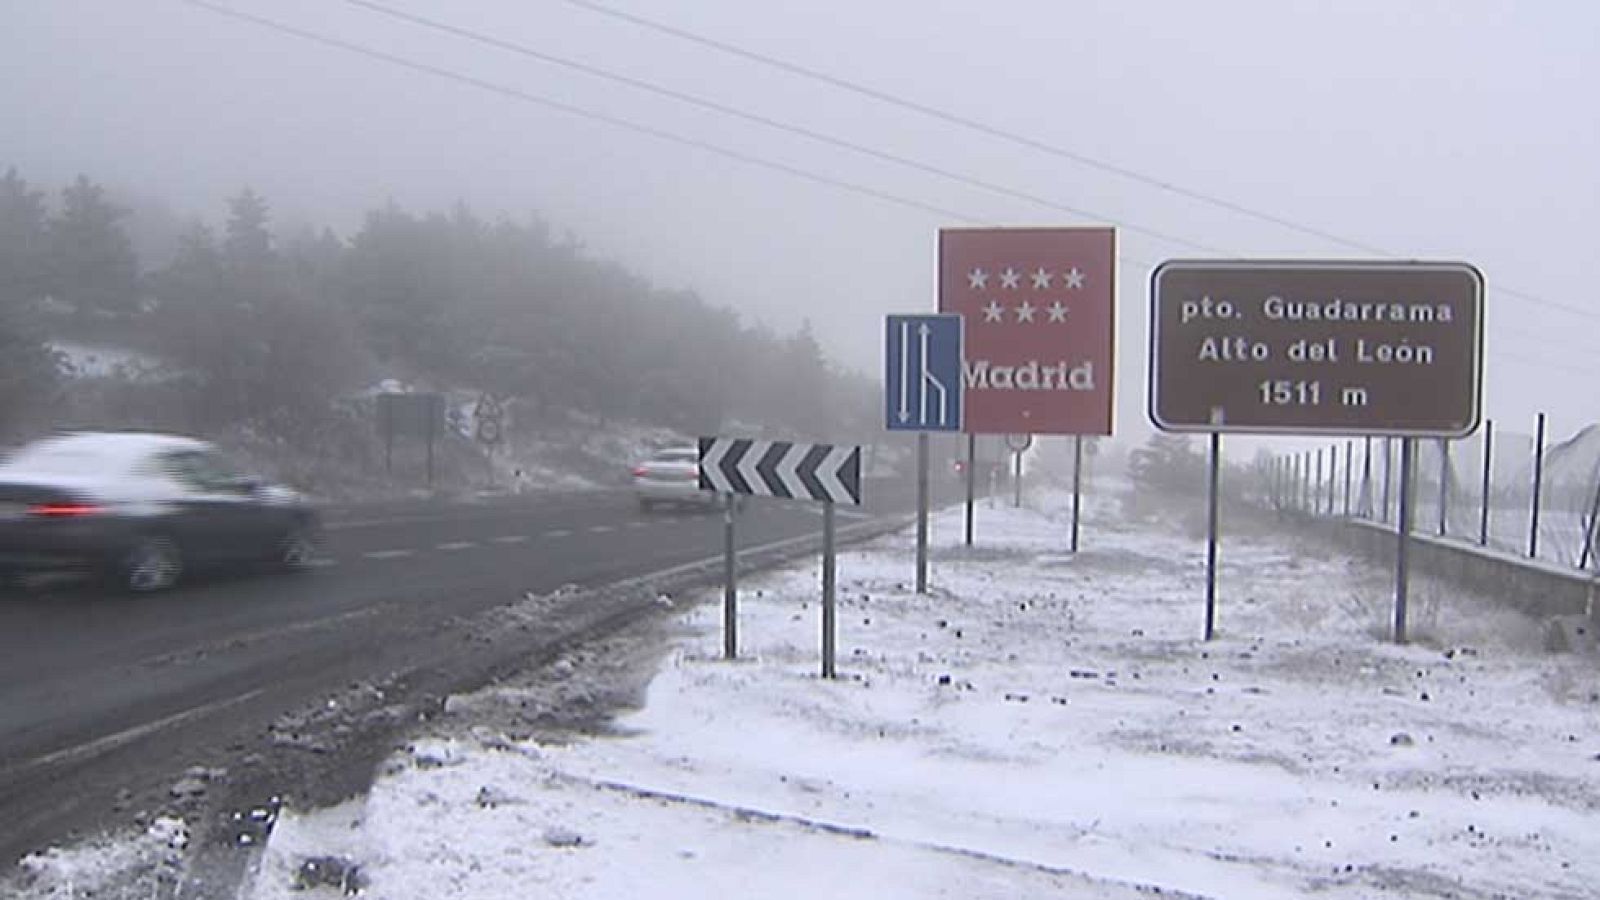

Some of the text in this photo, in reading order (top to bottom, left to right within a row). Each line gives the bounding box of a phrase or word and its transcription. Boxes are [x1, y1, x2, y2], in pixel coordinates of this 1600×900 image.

[1181, 295, 1453, 324] pto. Guadarrama
[1198, 337, 1433, 364] Alto del León
[962, 360, 1094, 390] Madrid
[1259, 381, 1367, 406] 1511 m
